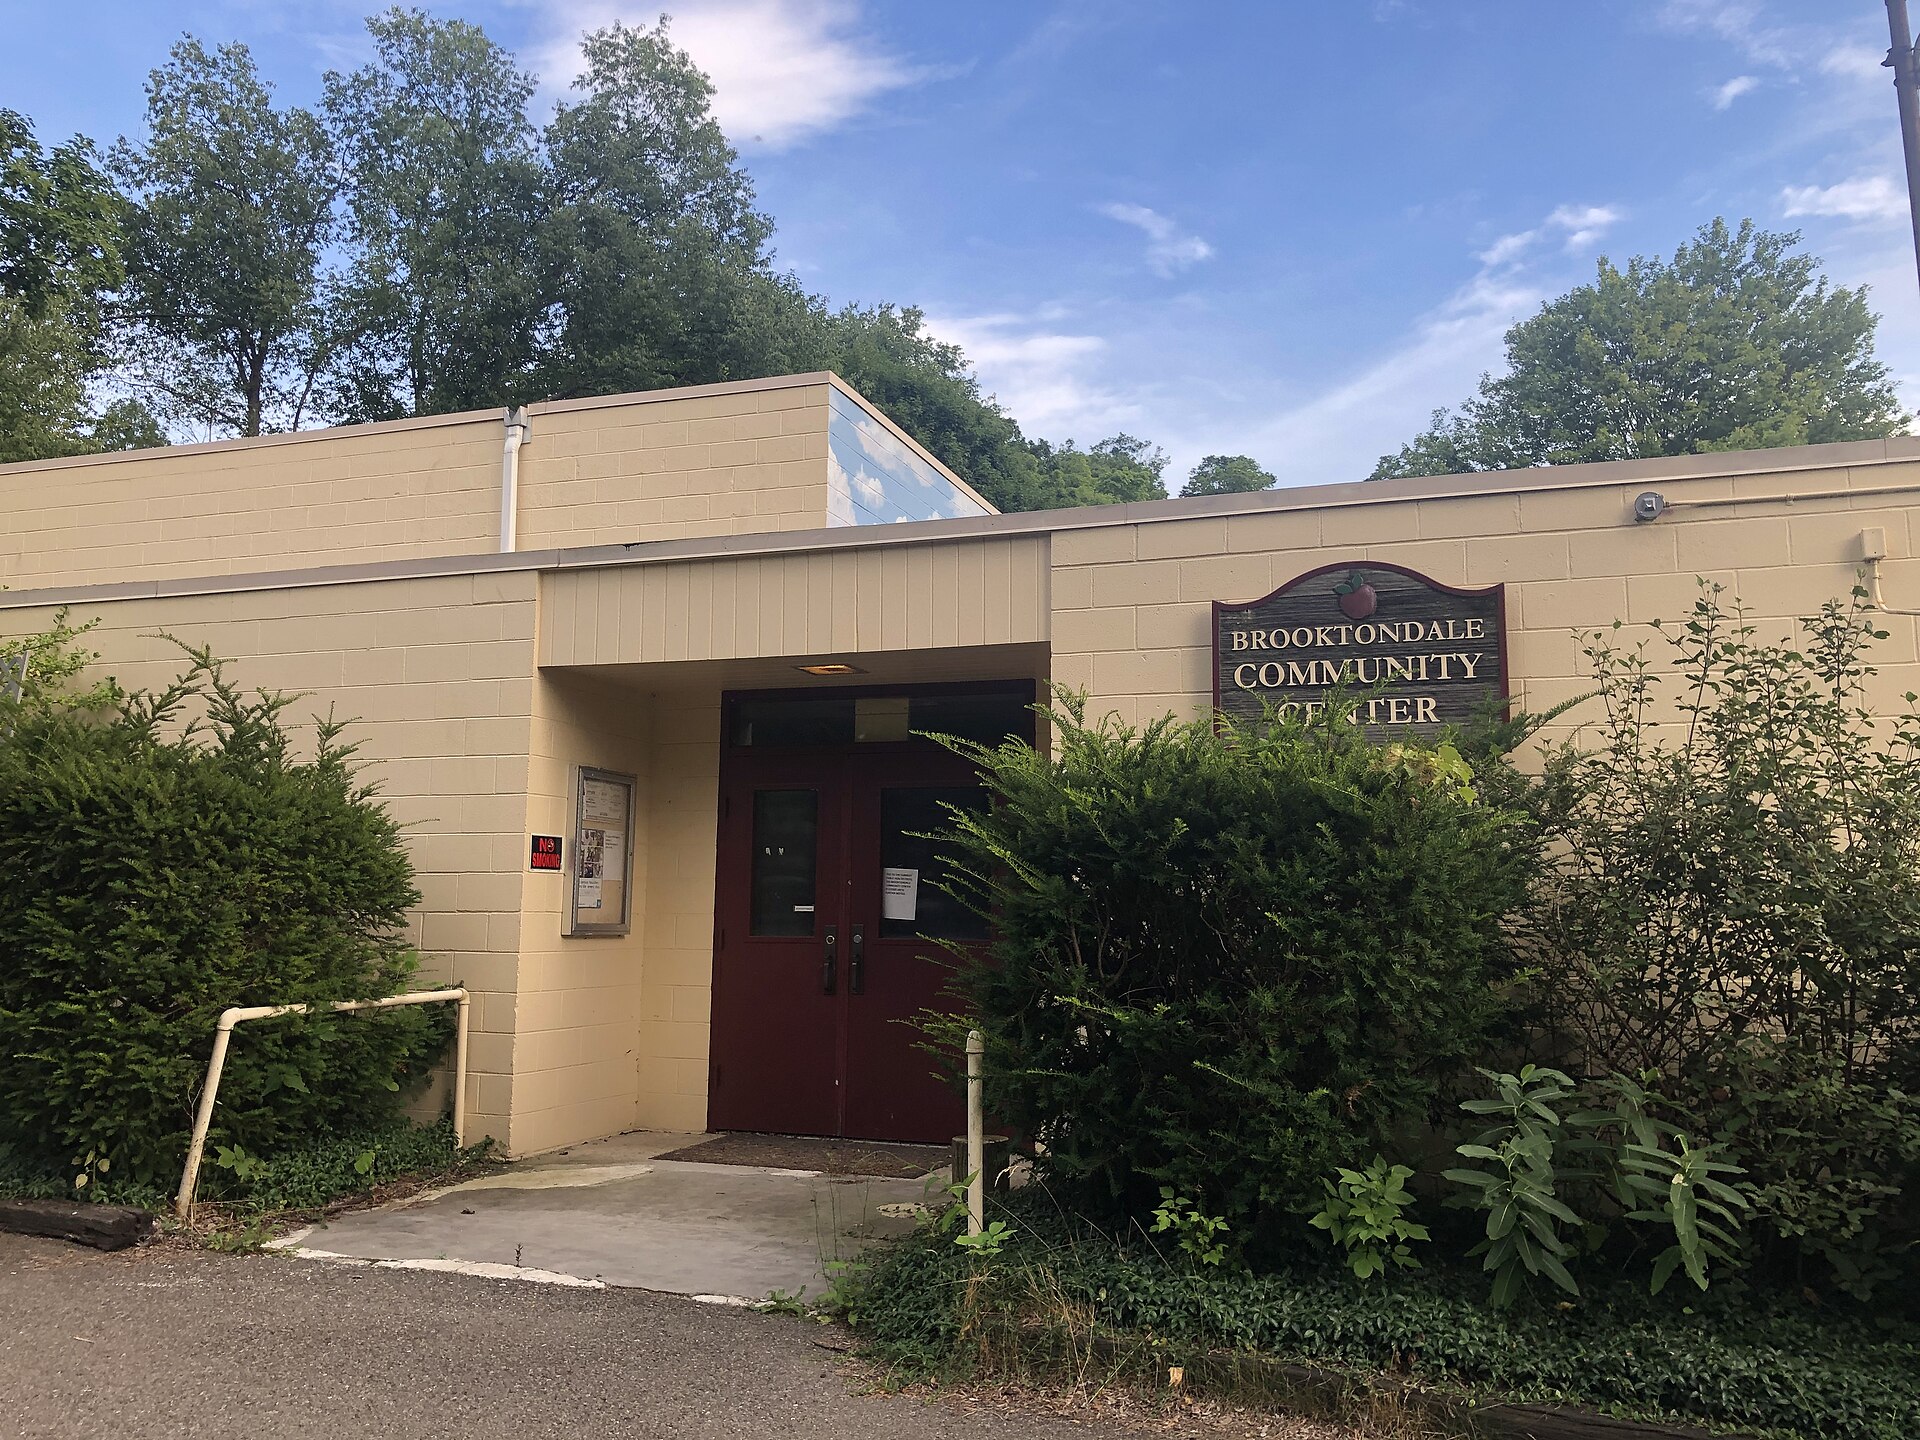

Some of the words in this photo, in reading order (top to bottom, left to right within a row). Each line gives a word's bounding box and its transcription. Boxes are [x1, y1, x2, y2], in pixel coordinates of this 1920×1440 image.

[1231, 618, 1485, 651] BROOKTONDALE
[1233, 653, 1483, 688] COMMUNITY
[539, 838, 554, 853] NO
[532, 853, 560, 868] SMOKING
